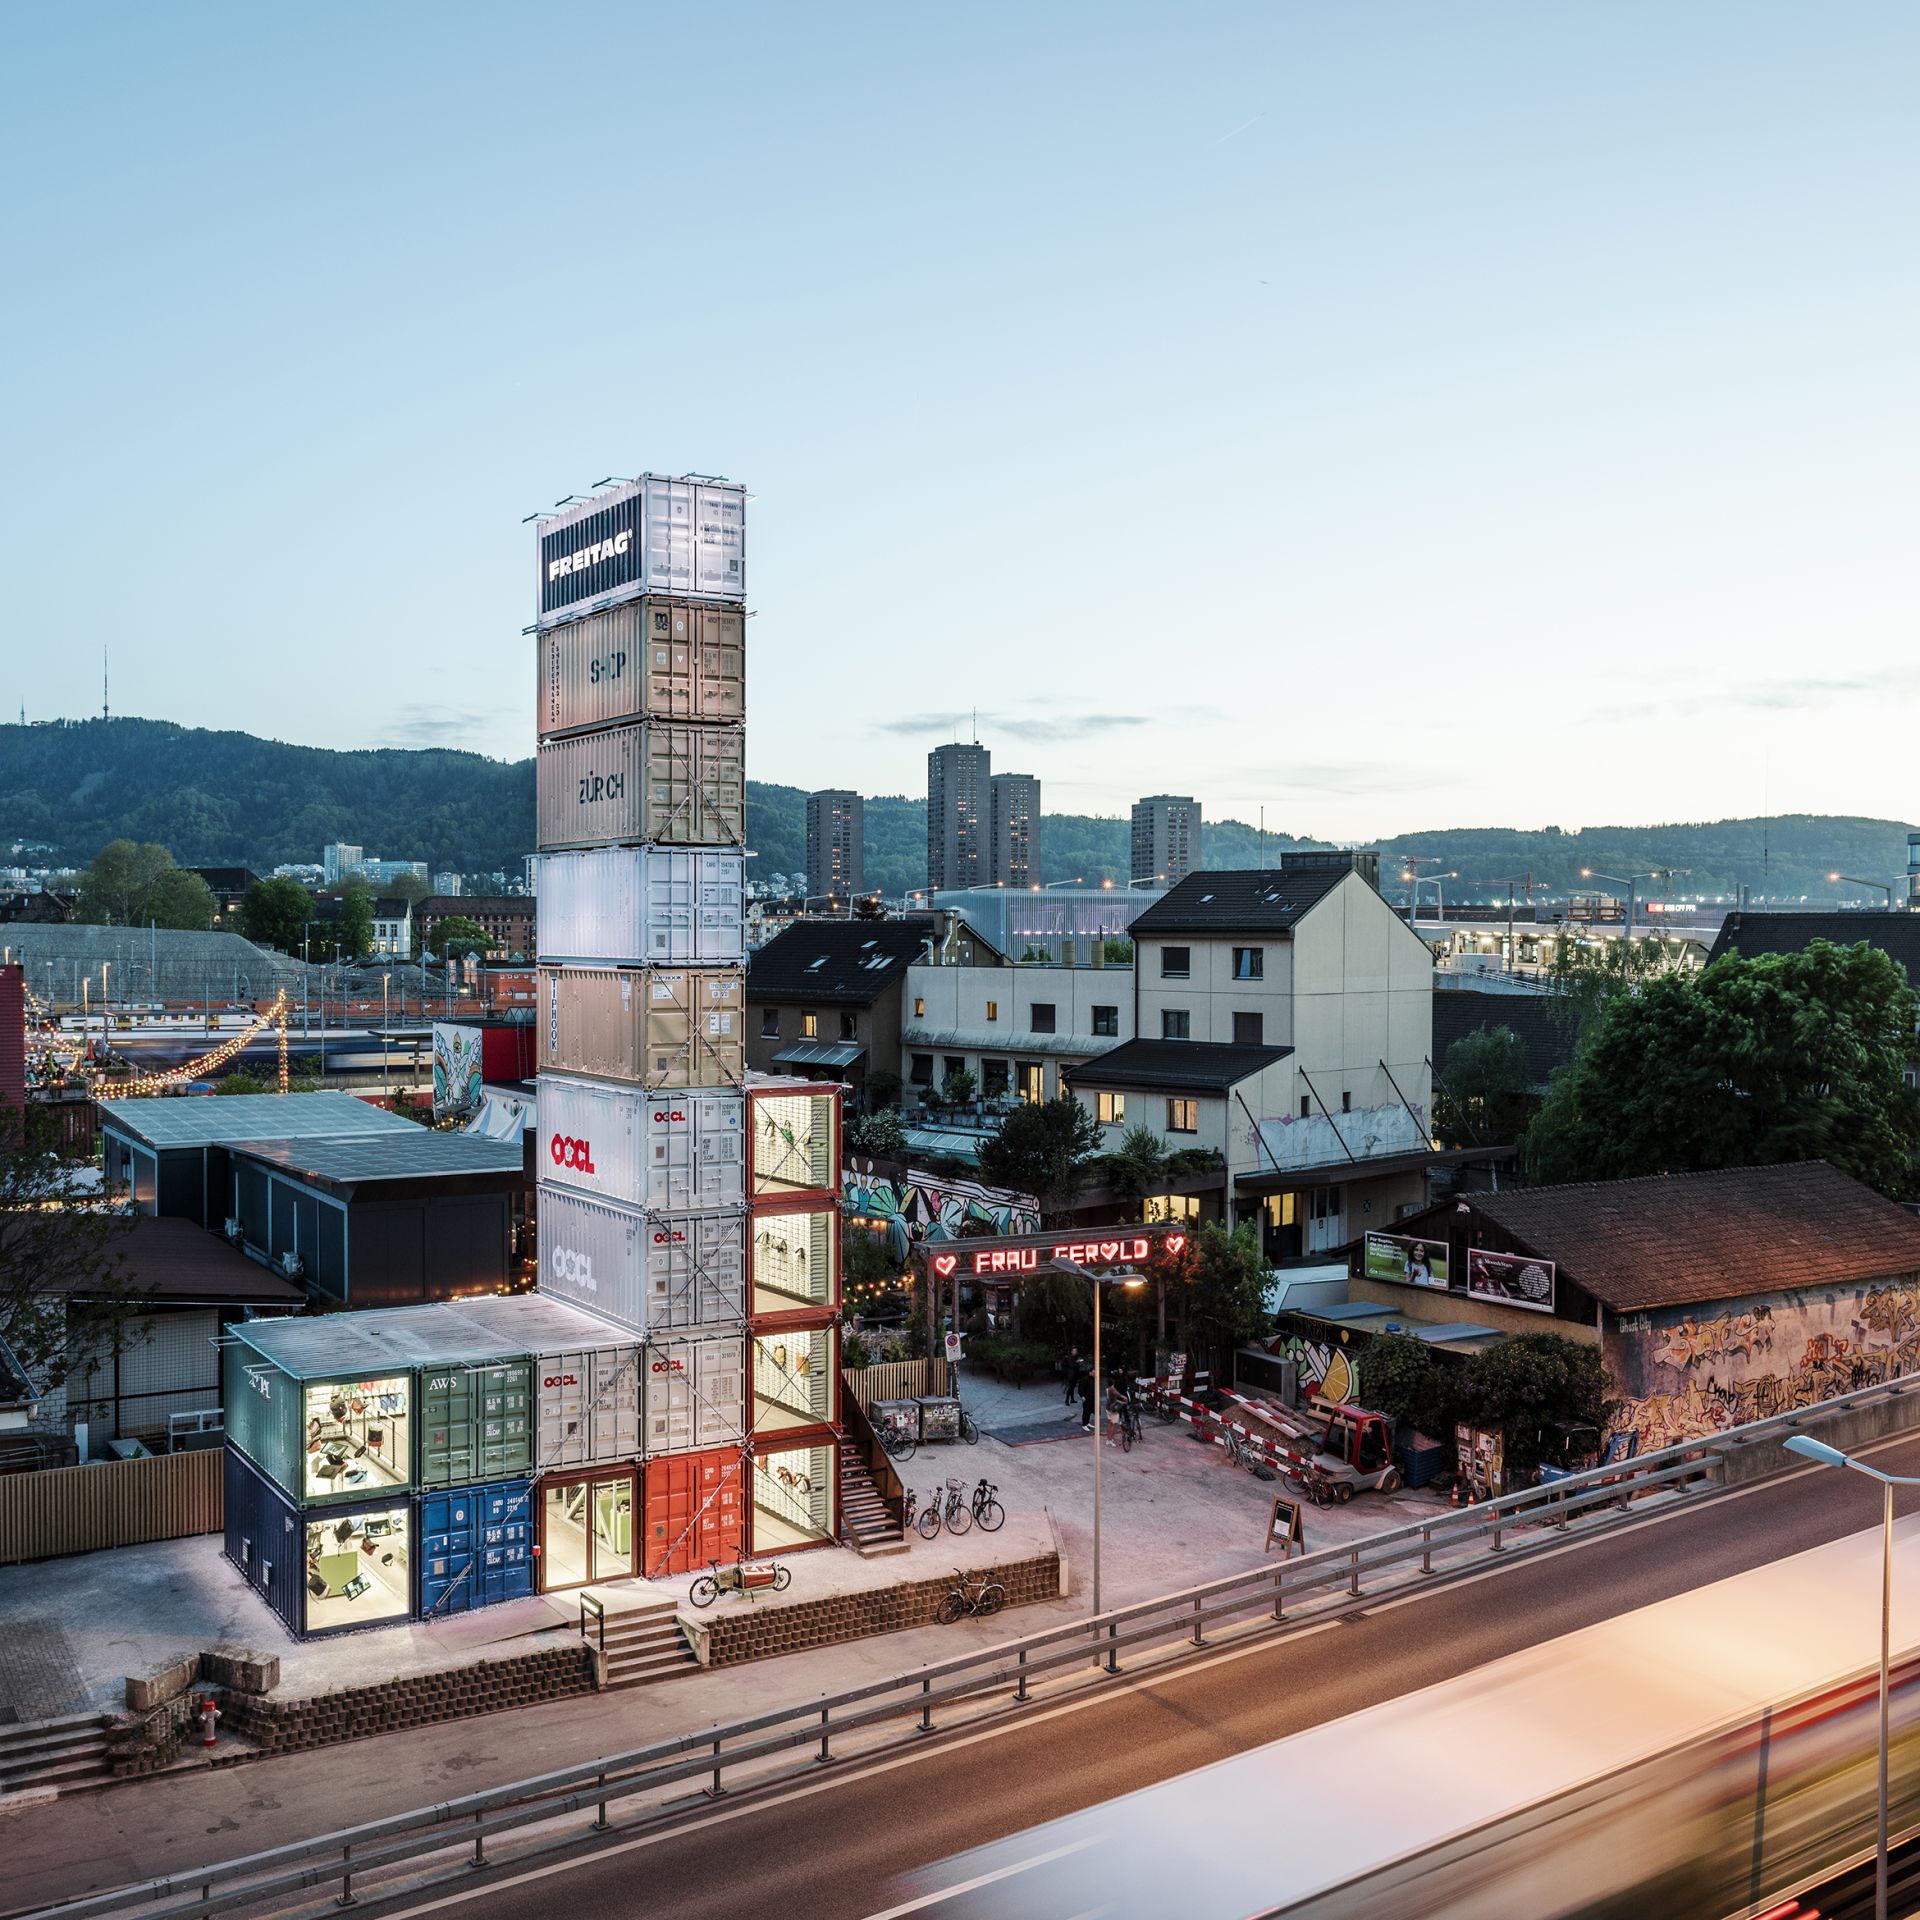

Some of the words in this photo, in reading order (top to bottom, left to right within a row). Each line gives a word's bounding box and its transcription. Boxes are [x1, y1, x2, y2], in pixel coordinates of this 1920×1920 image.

[580, 770, 624, 804] ZÜRCH
[654, 1111, 685, 1122] OOCL
[551, 1133, 594, 1174] OOCL
[654, 1231, 685, 1243] OOCL
[976, 1248, 1037, 1273] FRAU
[552, 1245, 596, 1292] OOCL
[1620, 1316, 1638, 1333] Ghost
[652, 1360, 683, 1373] OOCL
[429, 1377, 457, 1390] AWS
[544, 1374, 577, 1388] OOCL
